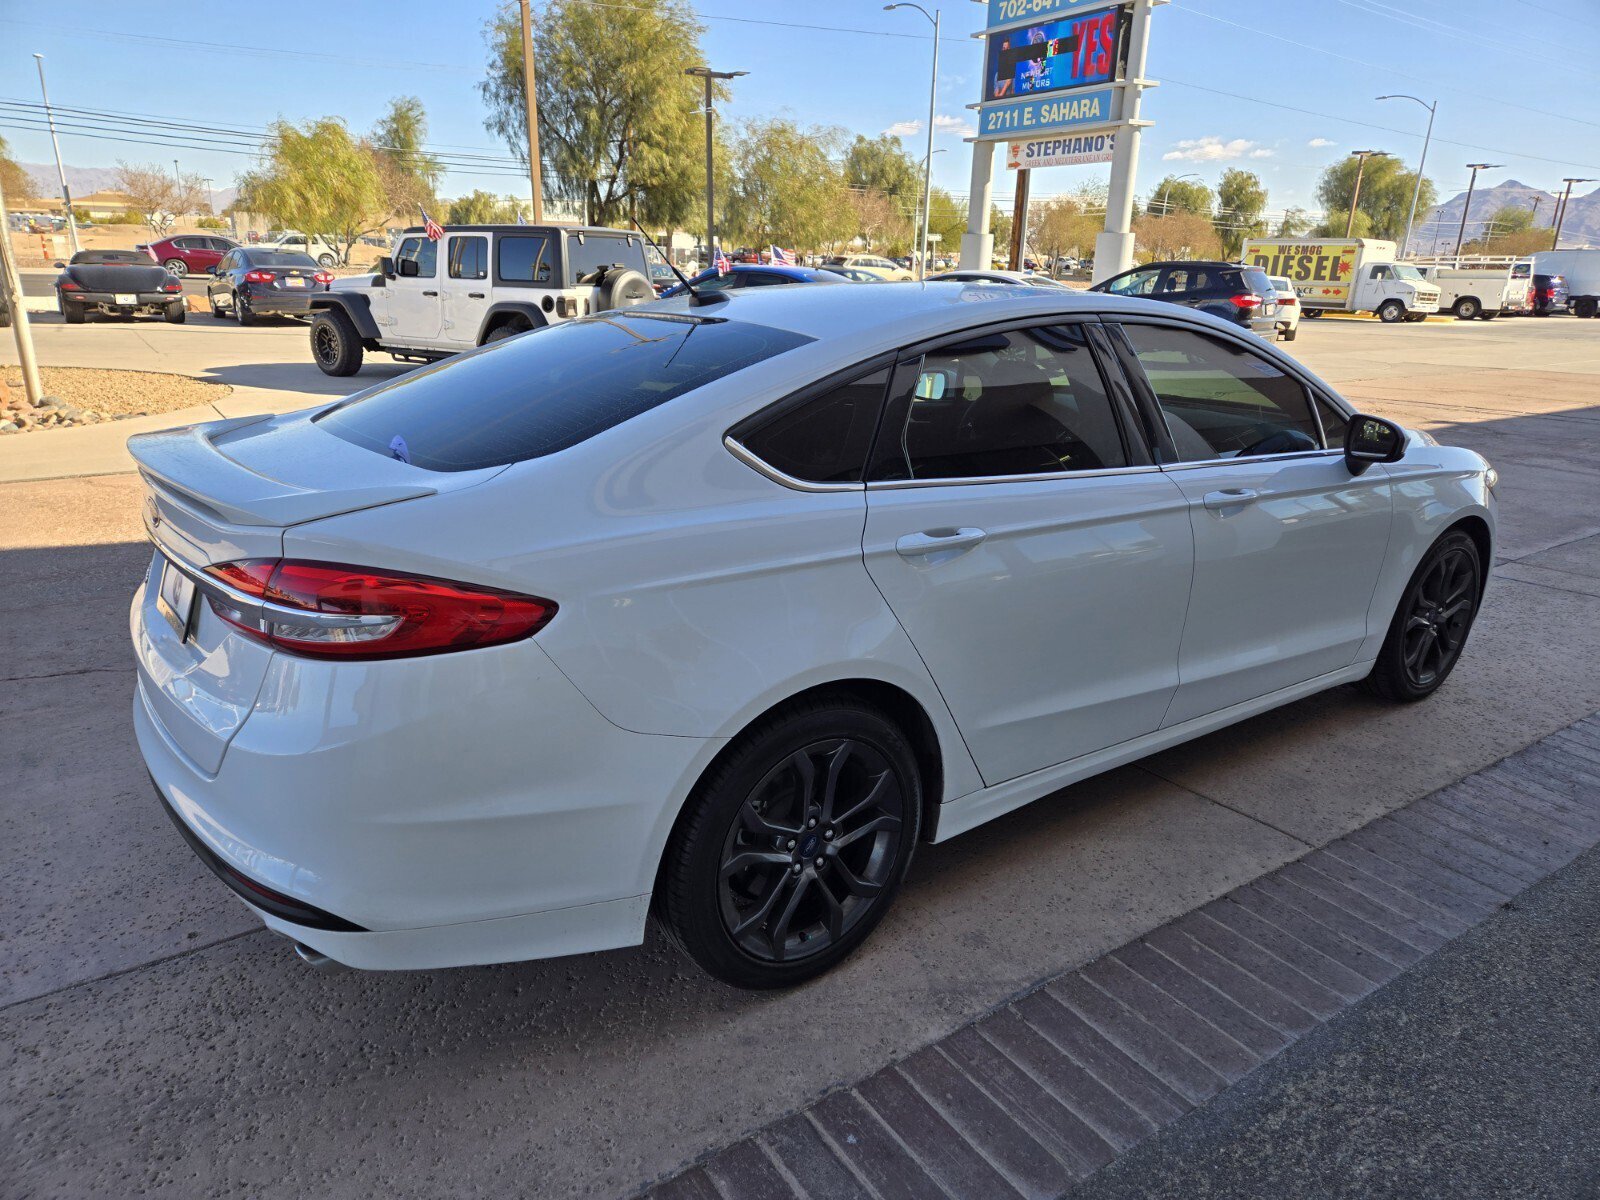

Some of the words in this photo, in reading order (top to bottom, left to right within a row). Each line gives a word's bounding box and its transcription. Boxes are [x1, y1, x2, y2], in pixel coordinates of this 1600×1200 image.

[1072, 14, 1115, 78] YES
[988, 109, 1018, 130] 2711
[1024, 107, 1036, 126] E.
[1040, 97, 1100, 124] SAHARA
[1024, 158, 1041, 168] GREEK
[1043, 157, 1054, 166] AND
[1278, 245, 1292, 255] WE
[1294, 245, 1322, 255] SMOG
[1254, 255, 1341, 281] DIESEL
